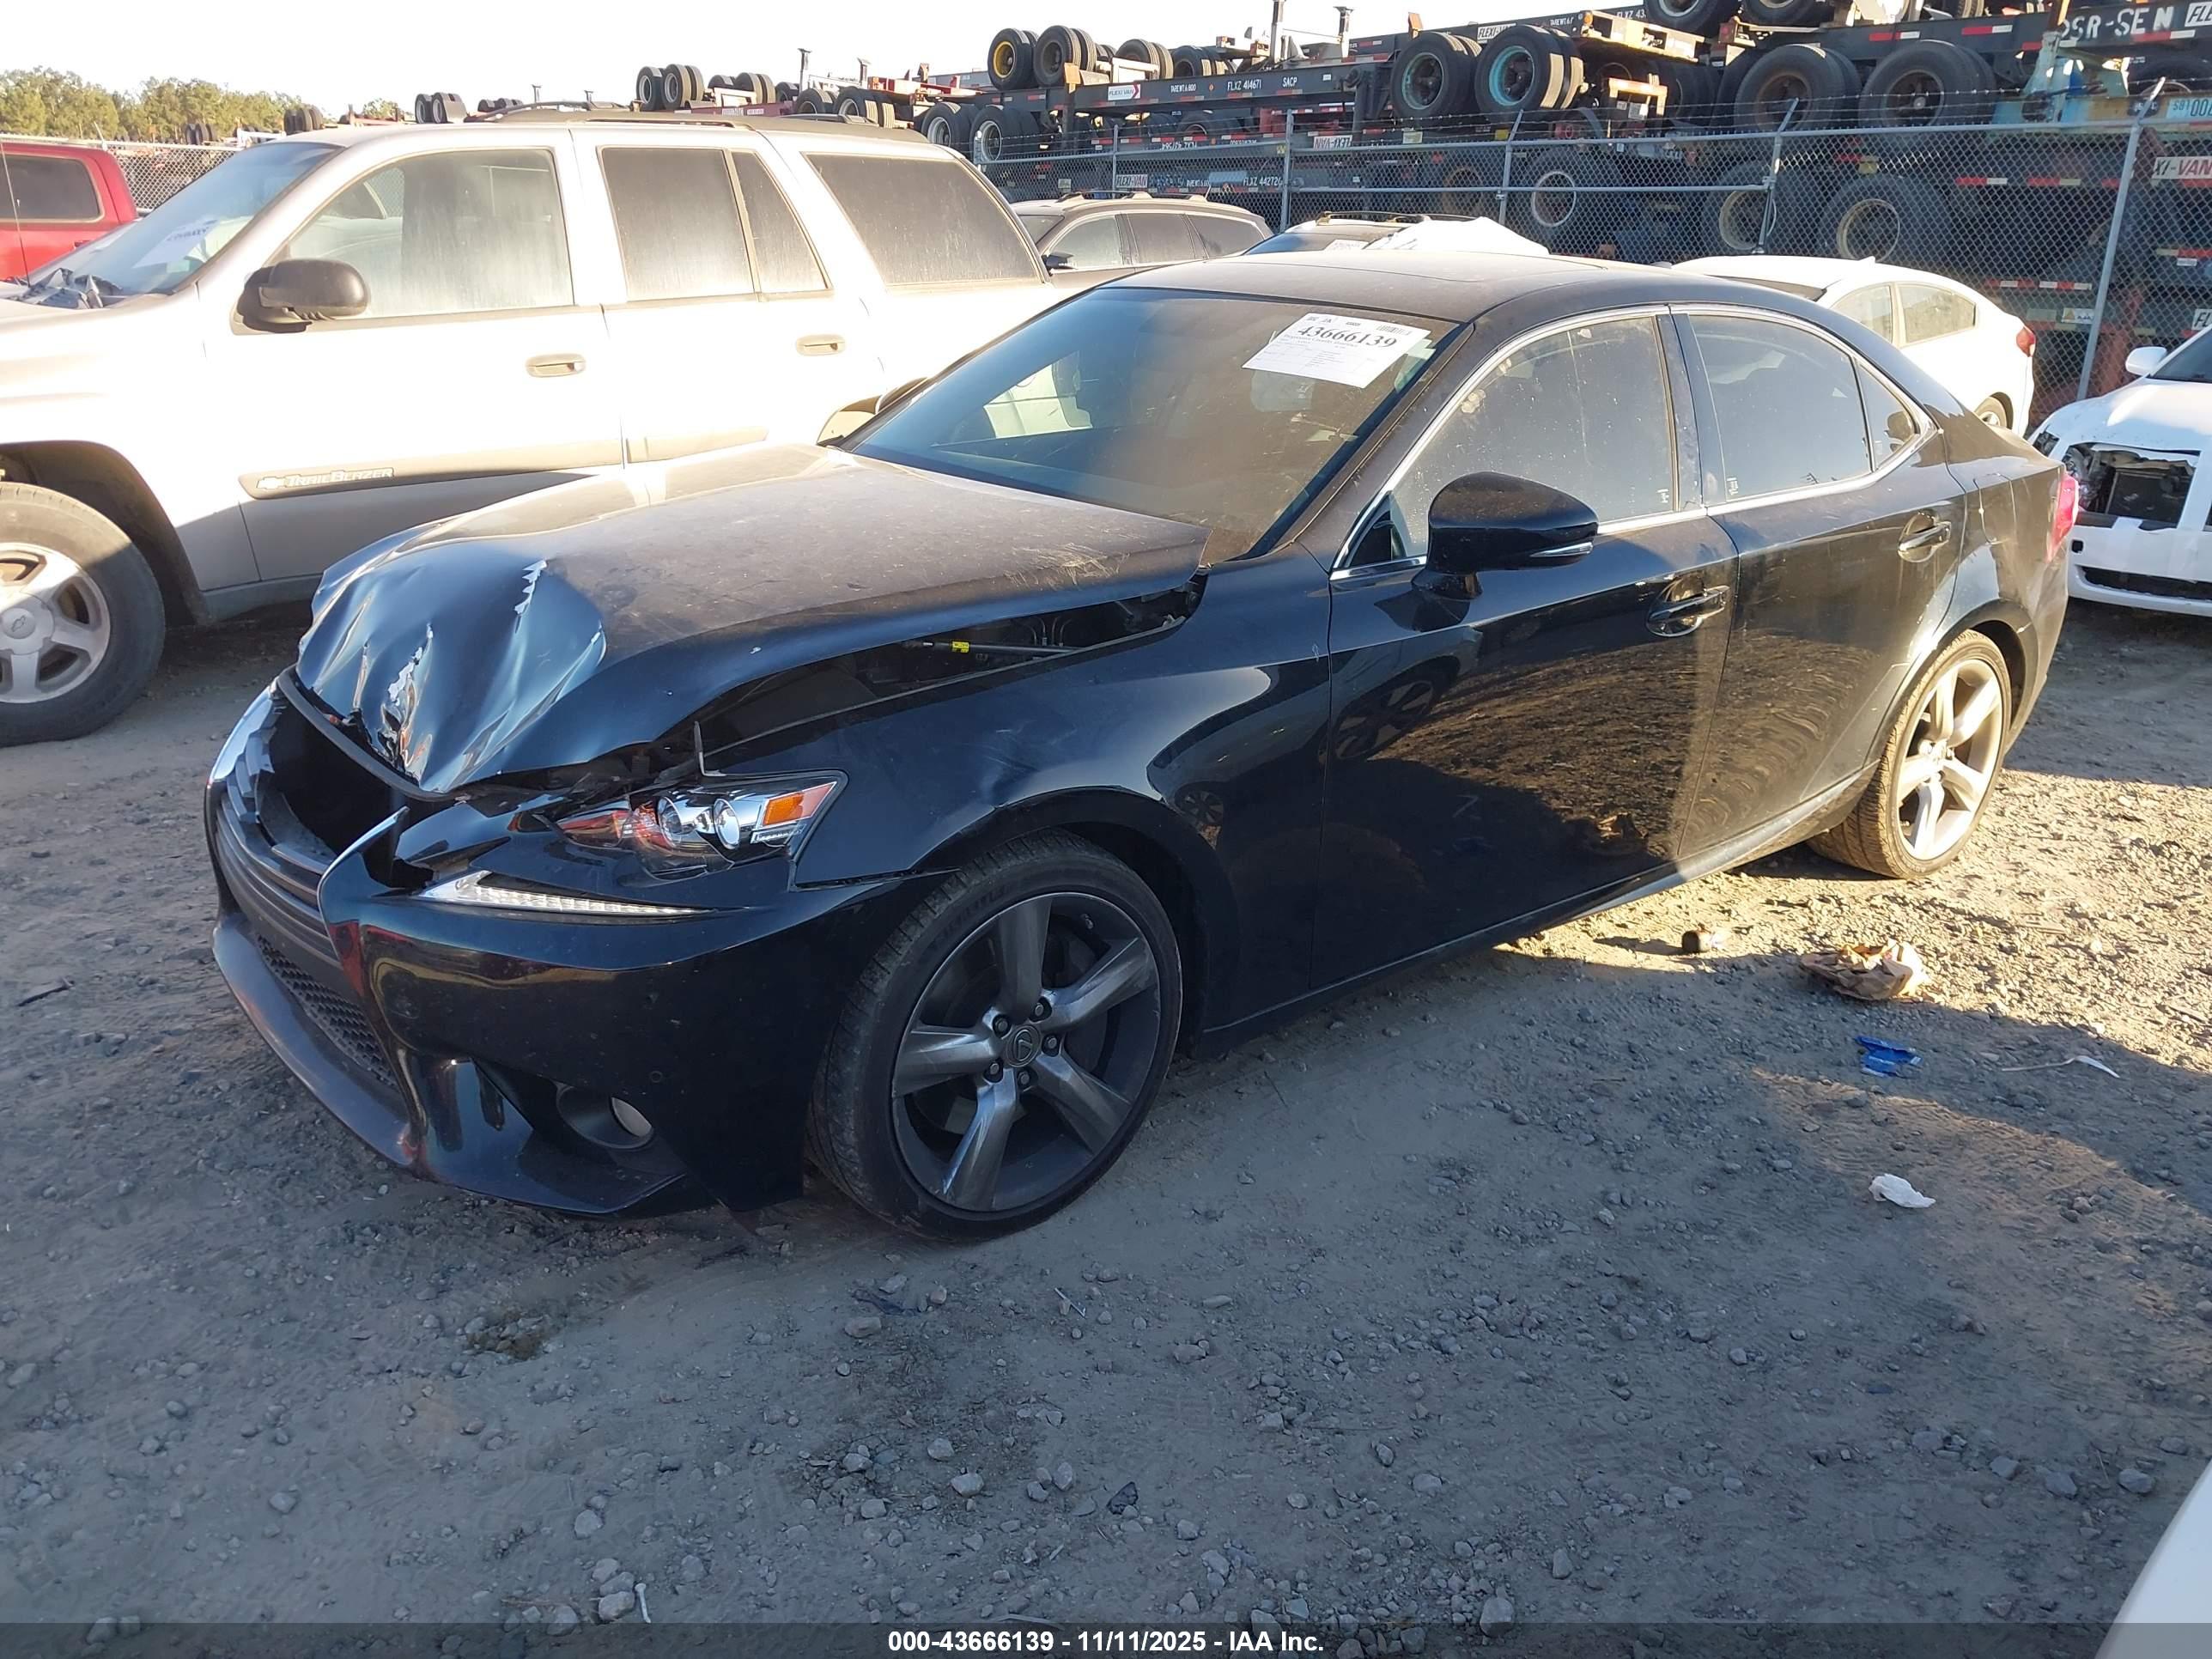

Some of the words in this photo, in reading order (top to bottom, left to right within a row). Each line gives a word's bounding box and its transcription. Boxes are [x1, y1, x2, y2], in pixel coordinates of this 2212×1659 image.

[1227, 81, 1242, 91] FLXZ
[1282, 76, 1297, 88] SACP
[1298, 325, 1397, 347] 43666139
